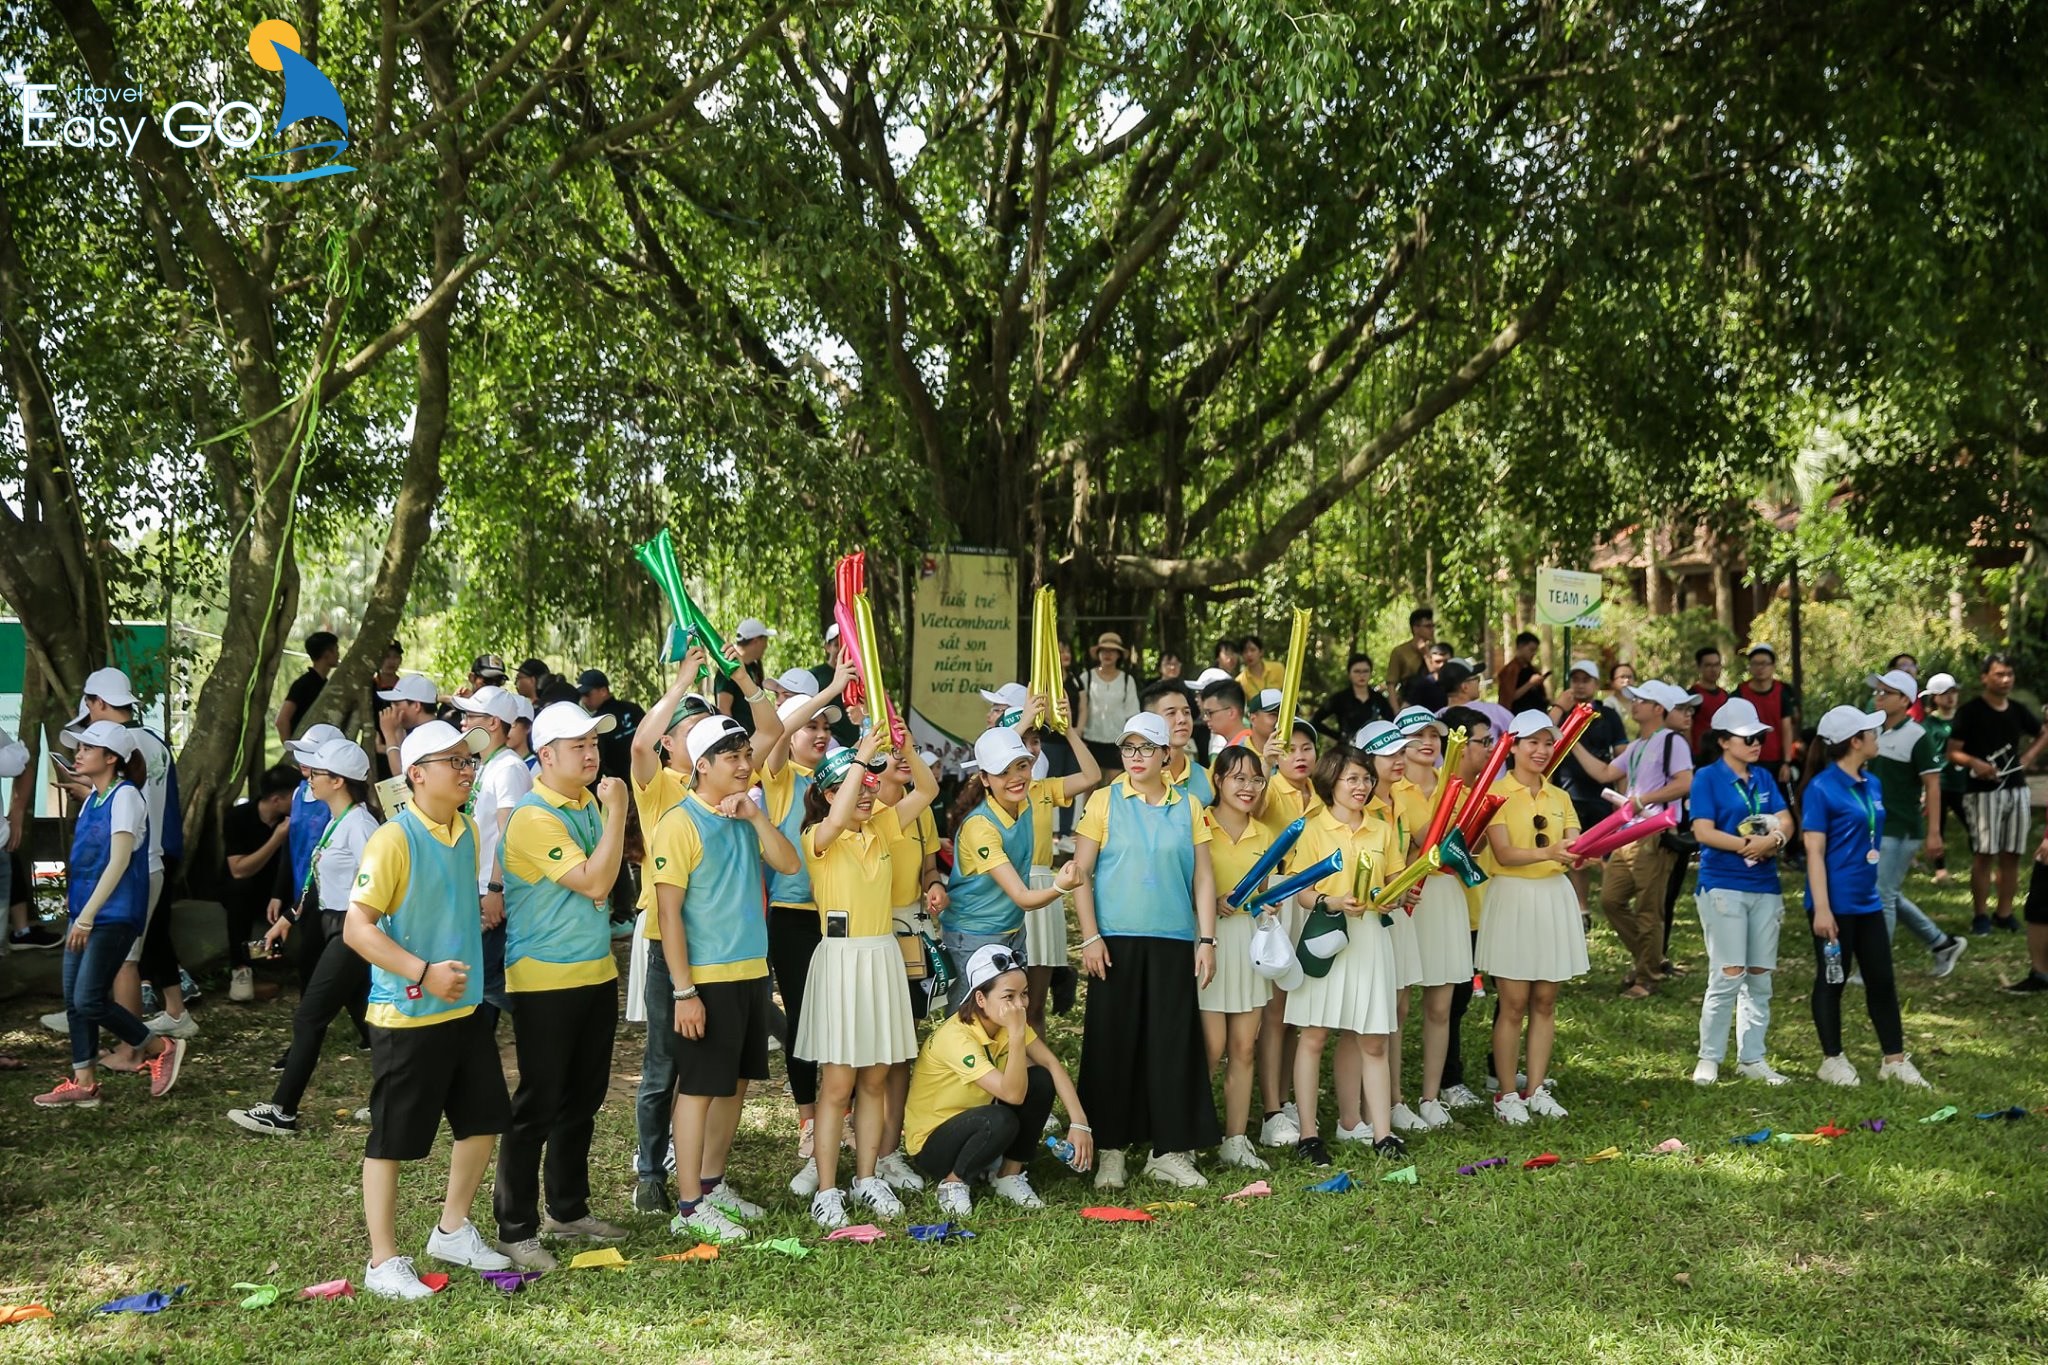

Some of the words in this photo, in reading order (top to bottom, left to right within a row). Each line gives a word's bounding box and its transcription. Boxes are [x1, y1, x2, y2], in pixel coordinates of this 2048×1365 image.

[1548, 589, 1579, 606] TEAM
[1582, 594, 1589, 606] 4
[921, 612, 1011, 630] Vietcombank
